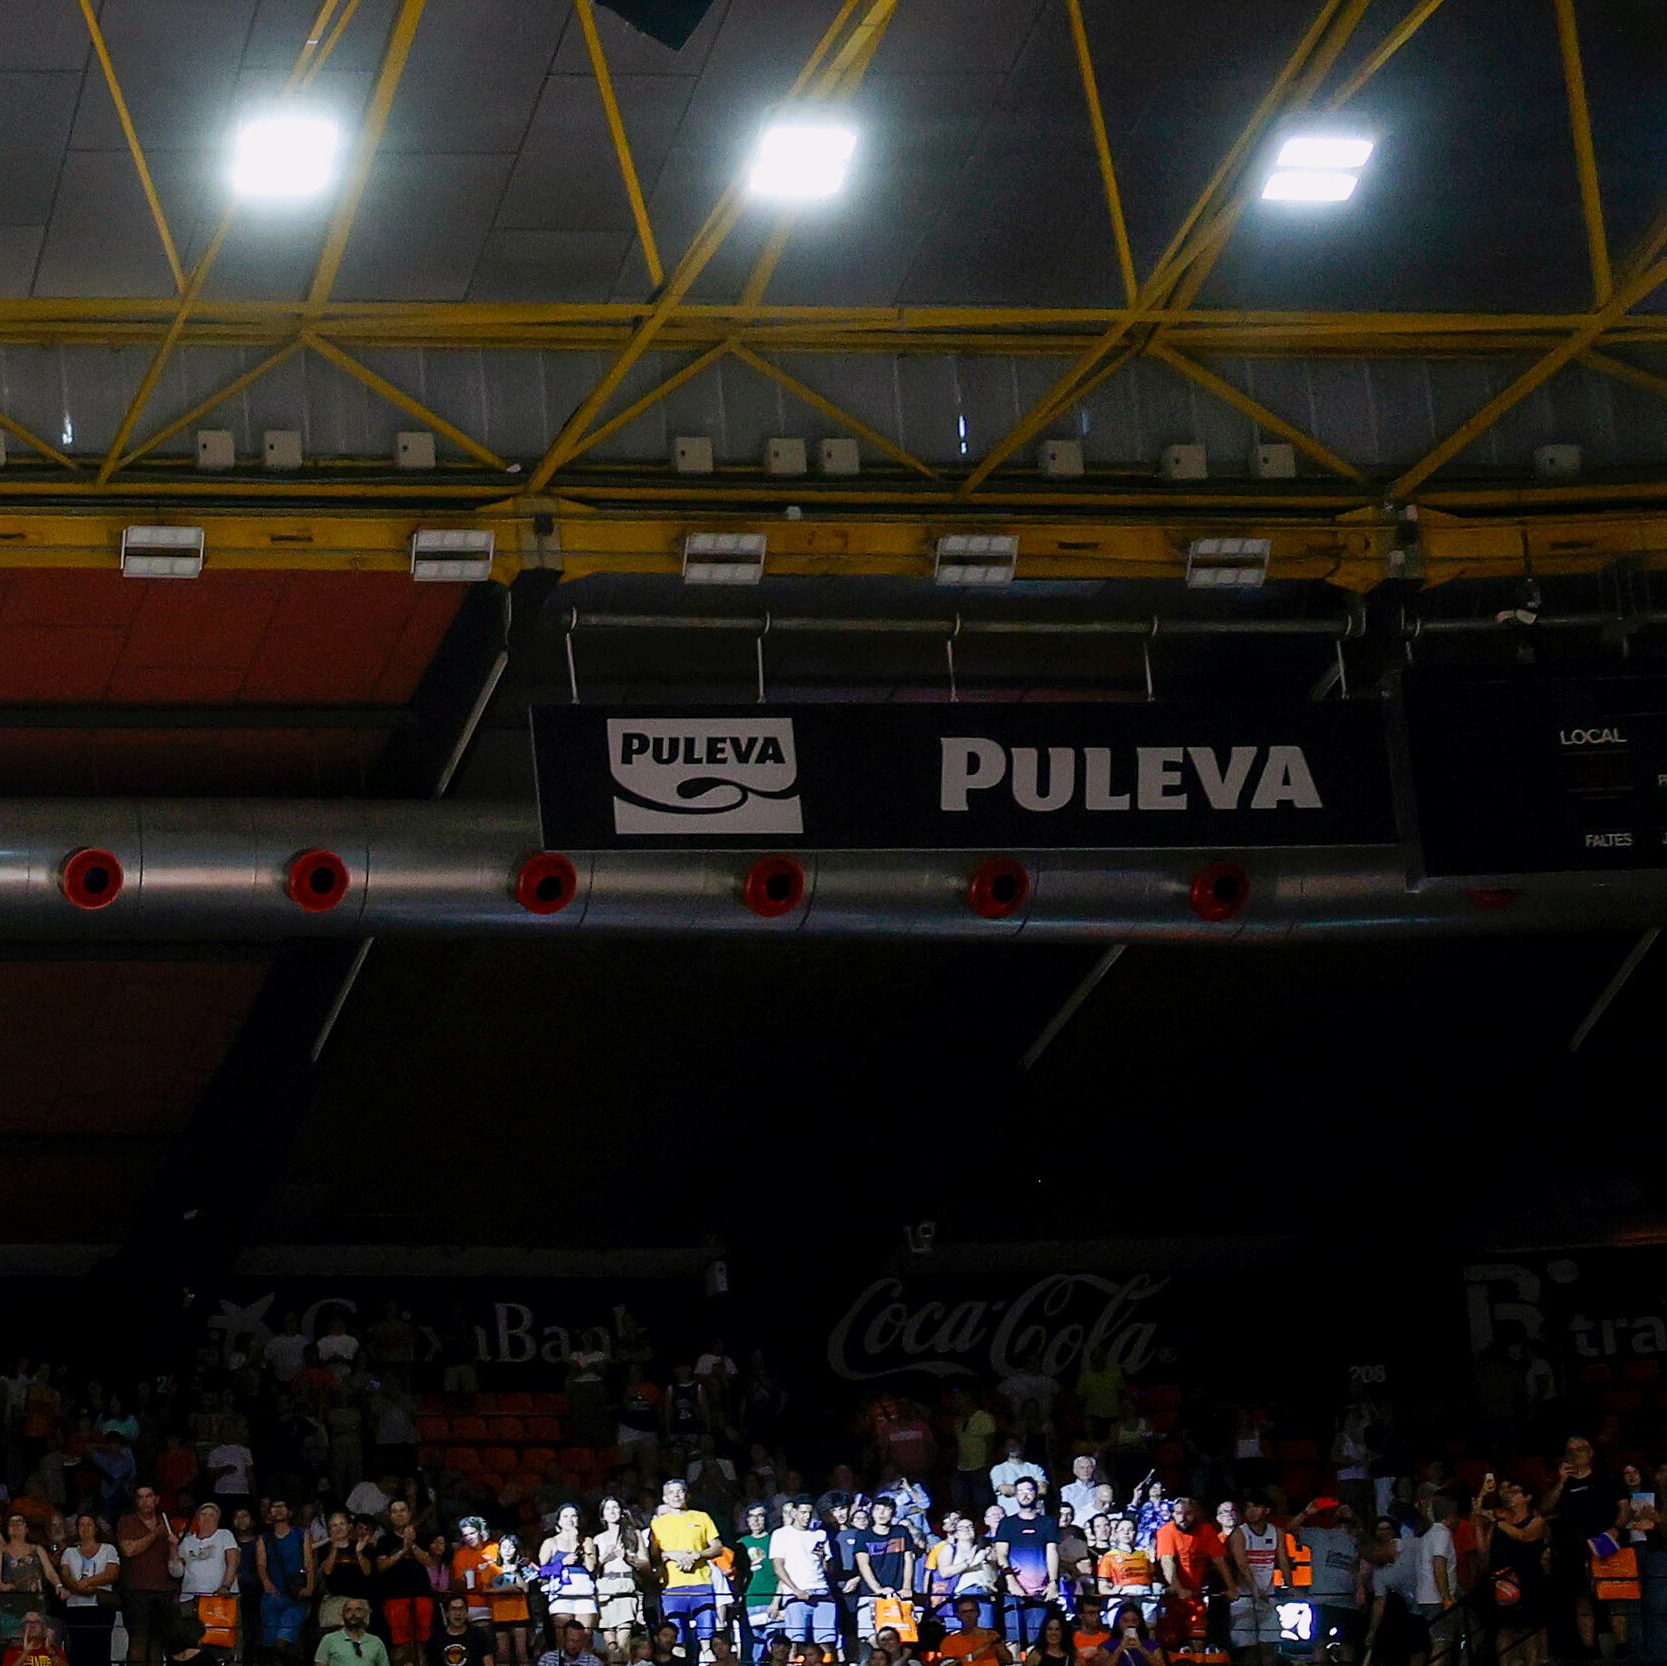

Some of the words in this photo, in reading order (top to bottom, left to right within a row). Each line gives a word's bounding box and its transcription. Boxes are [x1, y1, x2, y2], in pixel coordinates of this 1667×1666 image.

[620, 731, 785, 766] PULEVA
[1559, 728, 1627, 745] LOCAL
[940, 736, 1323, 812] PULEVA
[826, 1272, 1171, 1381] Coca-Cola
